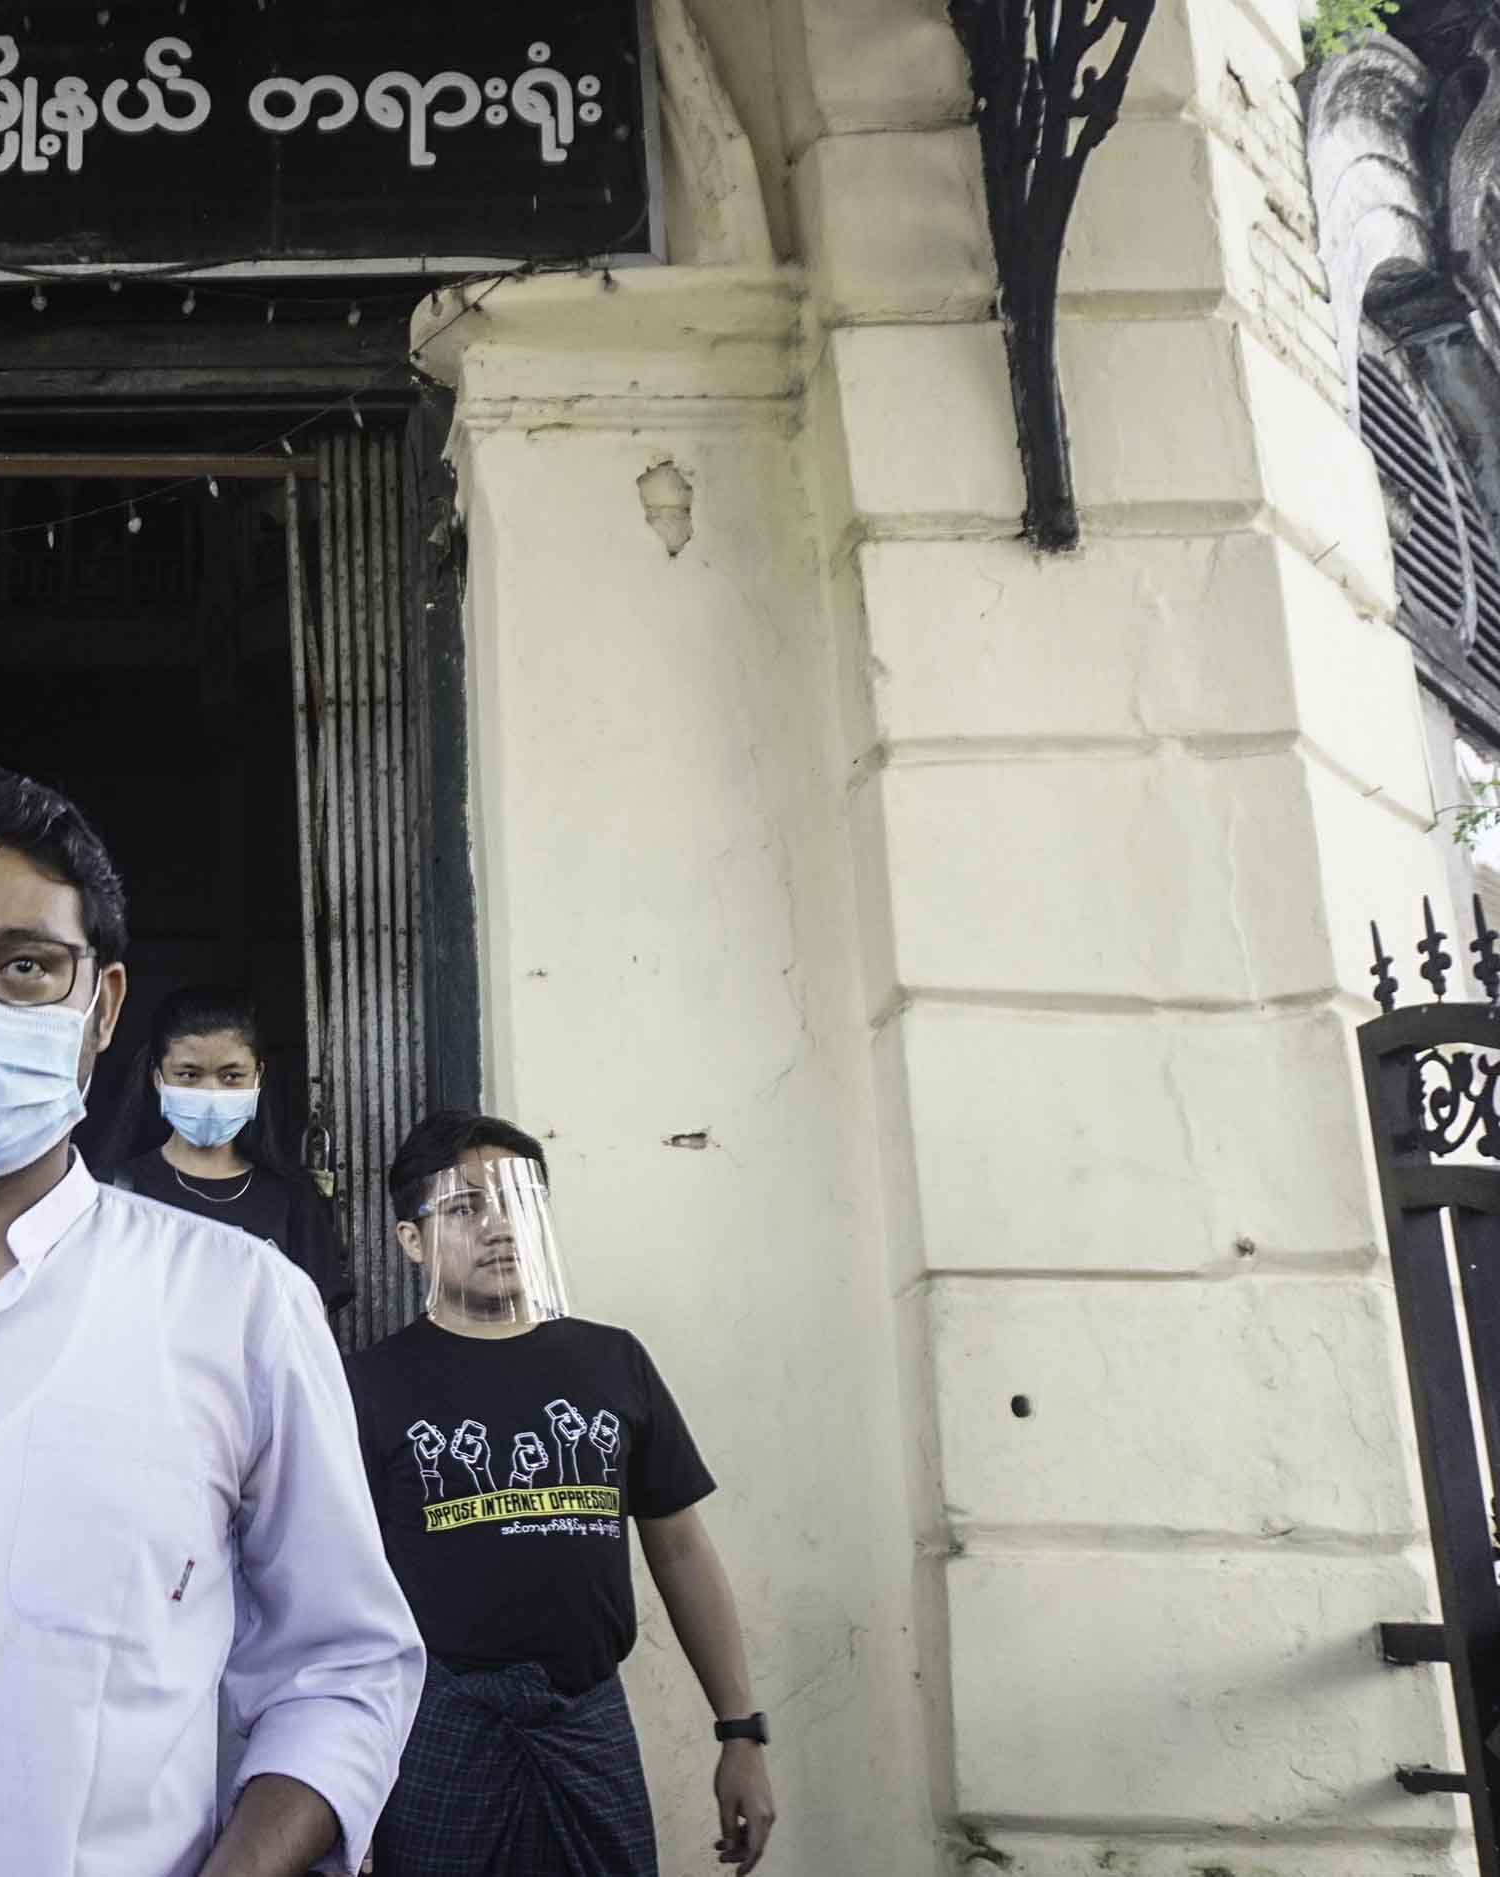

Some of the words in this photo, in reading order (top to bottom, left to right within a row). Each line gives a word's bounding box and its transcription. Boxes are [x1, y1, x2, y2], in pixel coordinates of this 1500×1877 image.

[248, 41, 602, 168] တရားရုံး
[428, 1502, 477, 1527] OPPOSE
[481, 1493, 545, 1516] INTERNET
[550, 1490, 618, 1511] OPPRESSION
